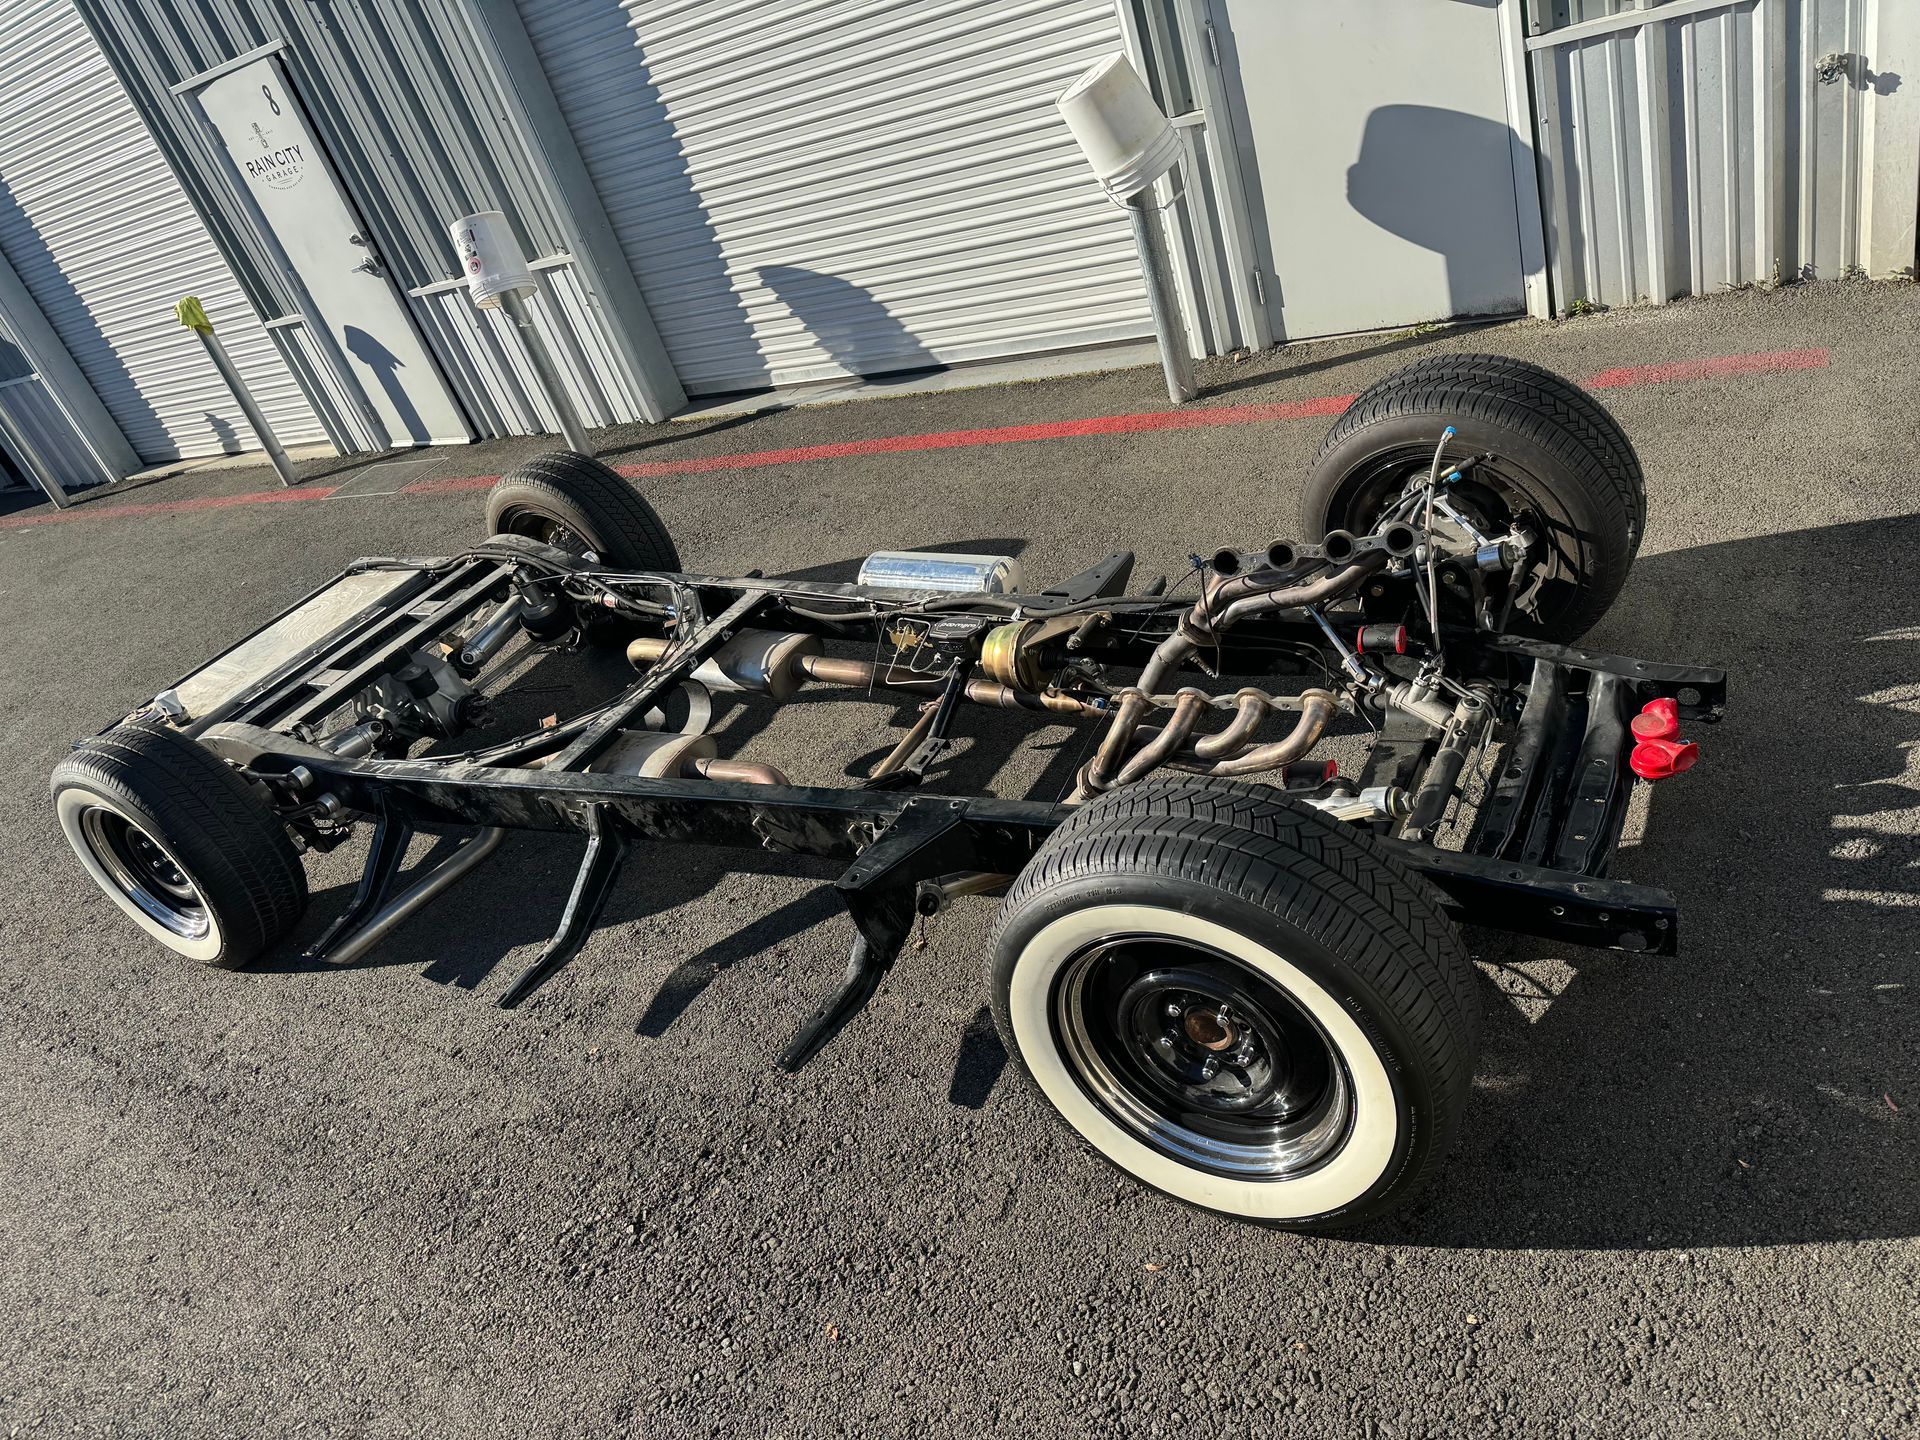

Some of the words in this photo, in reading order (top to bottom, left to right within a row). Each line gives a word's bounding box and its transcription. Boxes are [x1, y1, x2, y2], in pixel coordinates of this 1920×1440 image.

[262, 84, 281, 116] 8
[246, 154, 275, 178] RAIN
[275, 145, 304, 165] CITY
[266, 165, 299, 182] GARAGE
